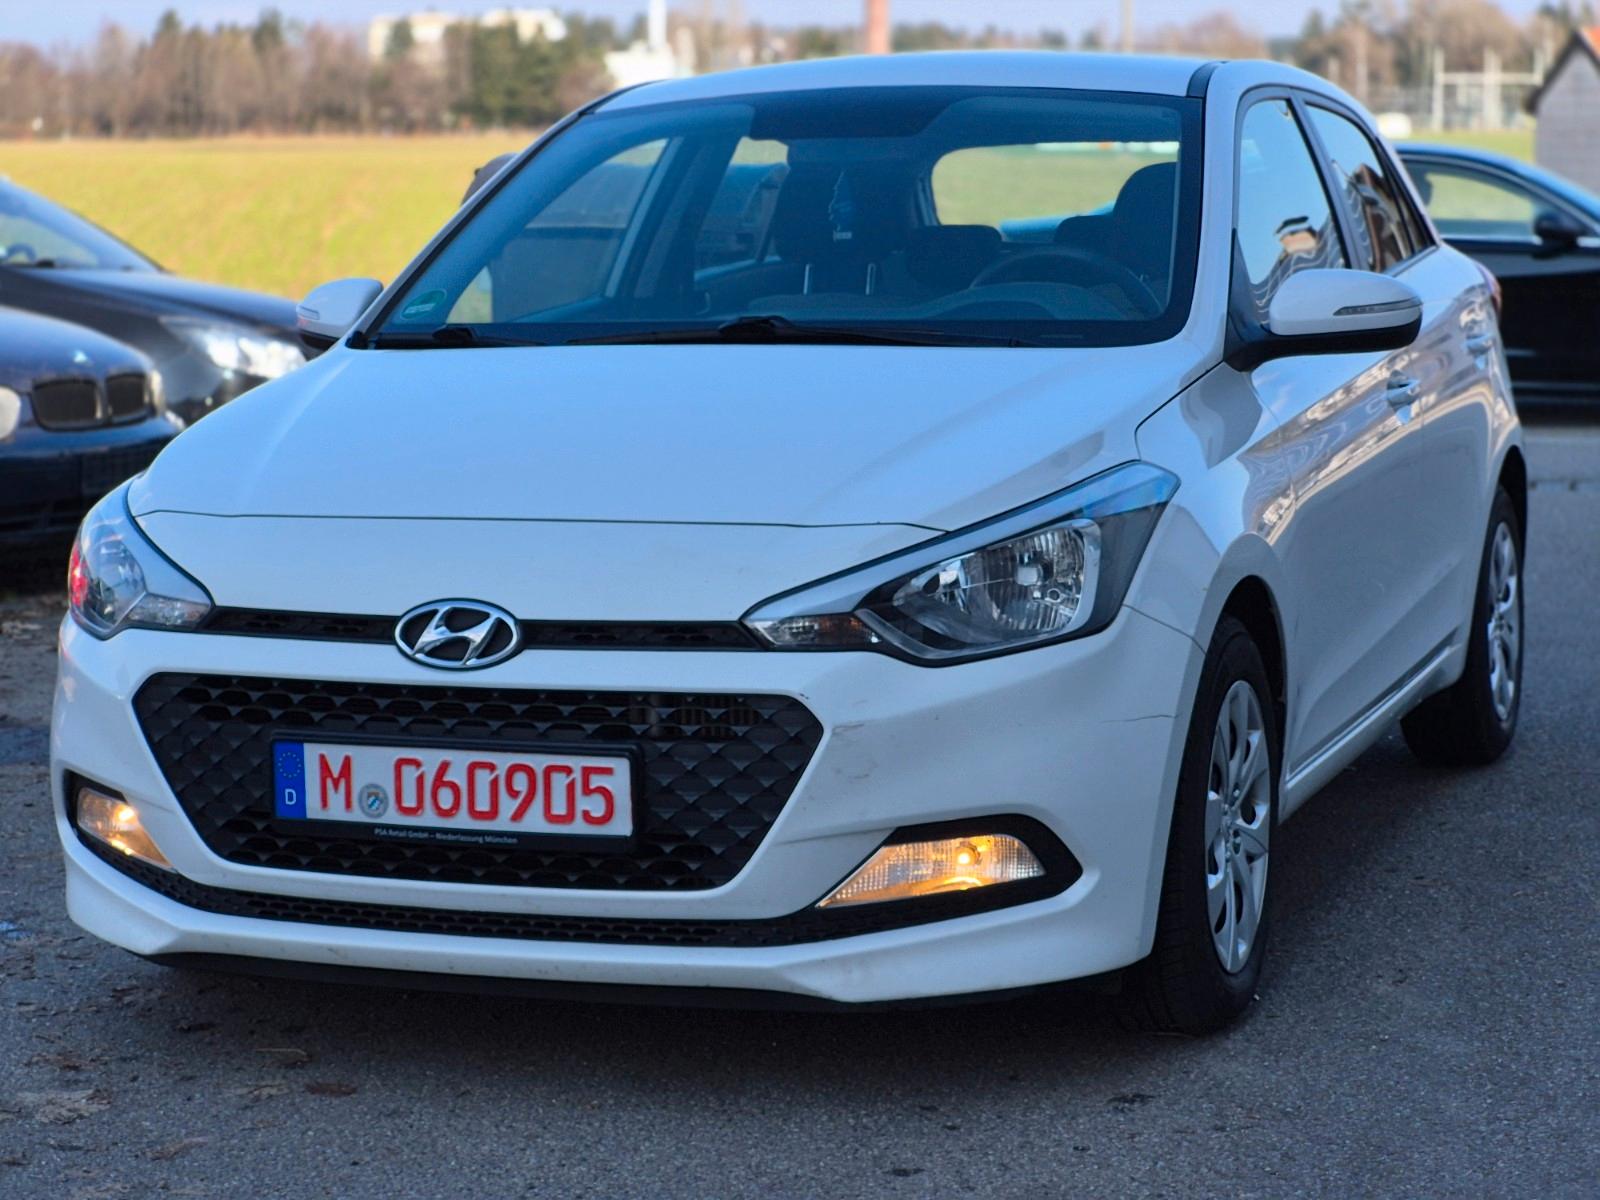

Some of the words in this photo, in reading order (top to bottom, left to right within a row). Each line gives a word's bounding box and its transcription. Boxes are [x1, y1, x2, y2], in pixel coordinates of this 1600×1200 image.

[285, 788, 297, 805] D
[318, 752, 353, 812] M
[393, 756, 616, 826] 060905
[408, 829, 429, 839] GmbH
[435, 832, 484, 844] Niederlassung
[484, 835, 518, 844] München
